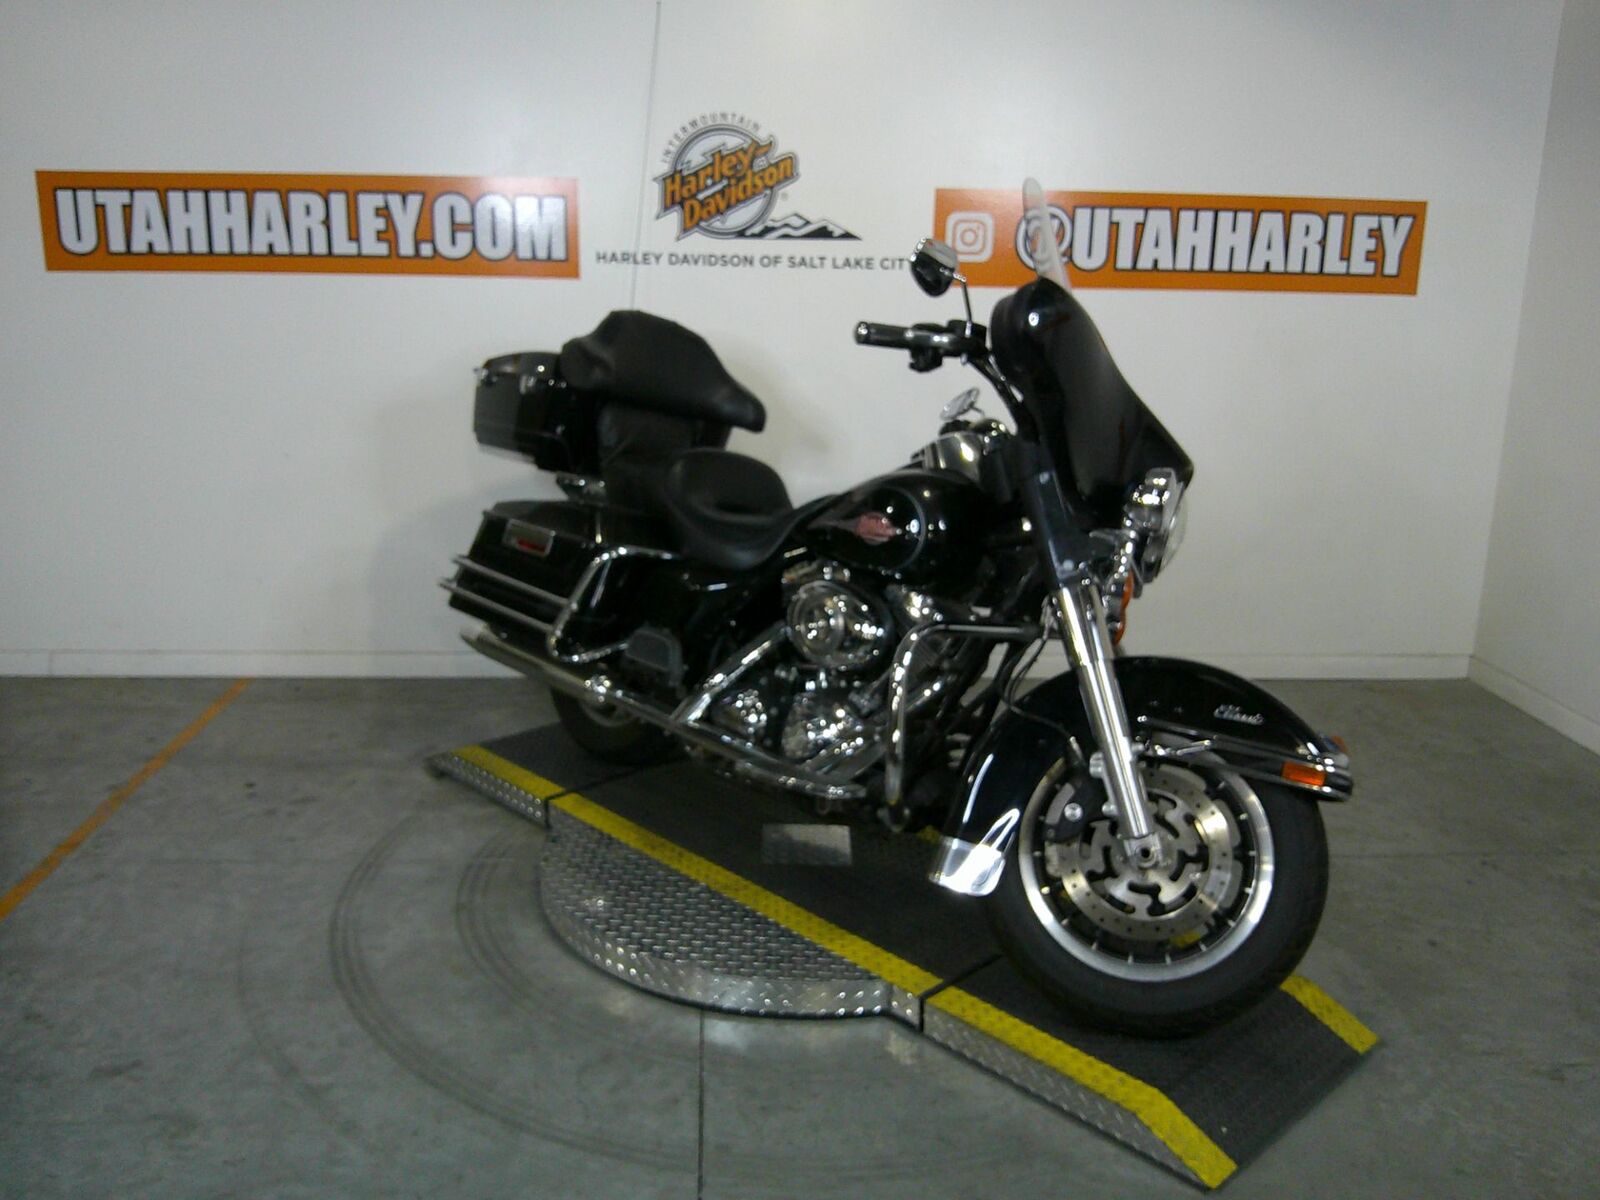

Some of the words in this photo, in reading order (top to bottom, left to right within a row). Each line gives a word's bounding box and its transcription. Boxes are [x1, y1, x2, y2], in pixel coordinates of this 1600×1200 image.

[663, 138, 773, 209] Harley
[682, 156, 794, 230] Davidson
[54, 188, 568, 262] UTAHHARLEY.COM
[596, 252, 663, 265] HARLEY
[668, 253, 754, 267] DAVIDSON
[759, 255, 782, 268] OF
[787, 256, 827, 268] SALT
[831, 257, 875, 270] LAKE
